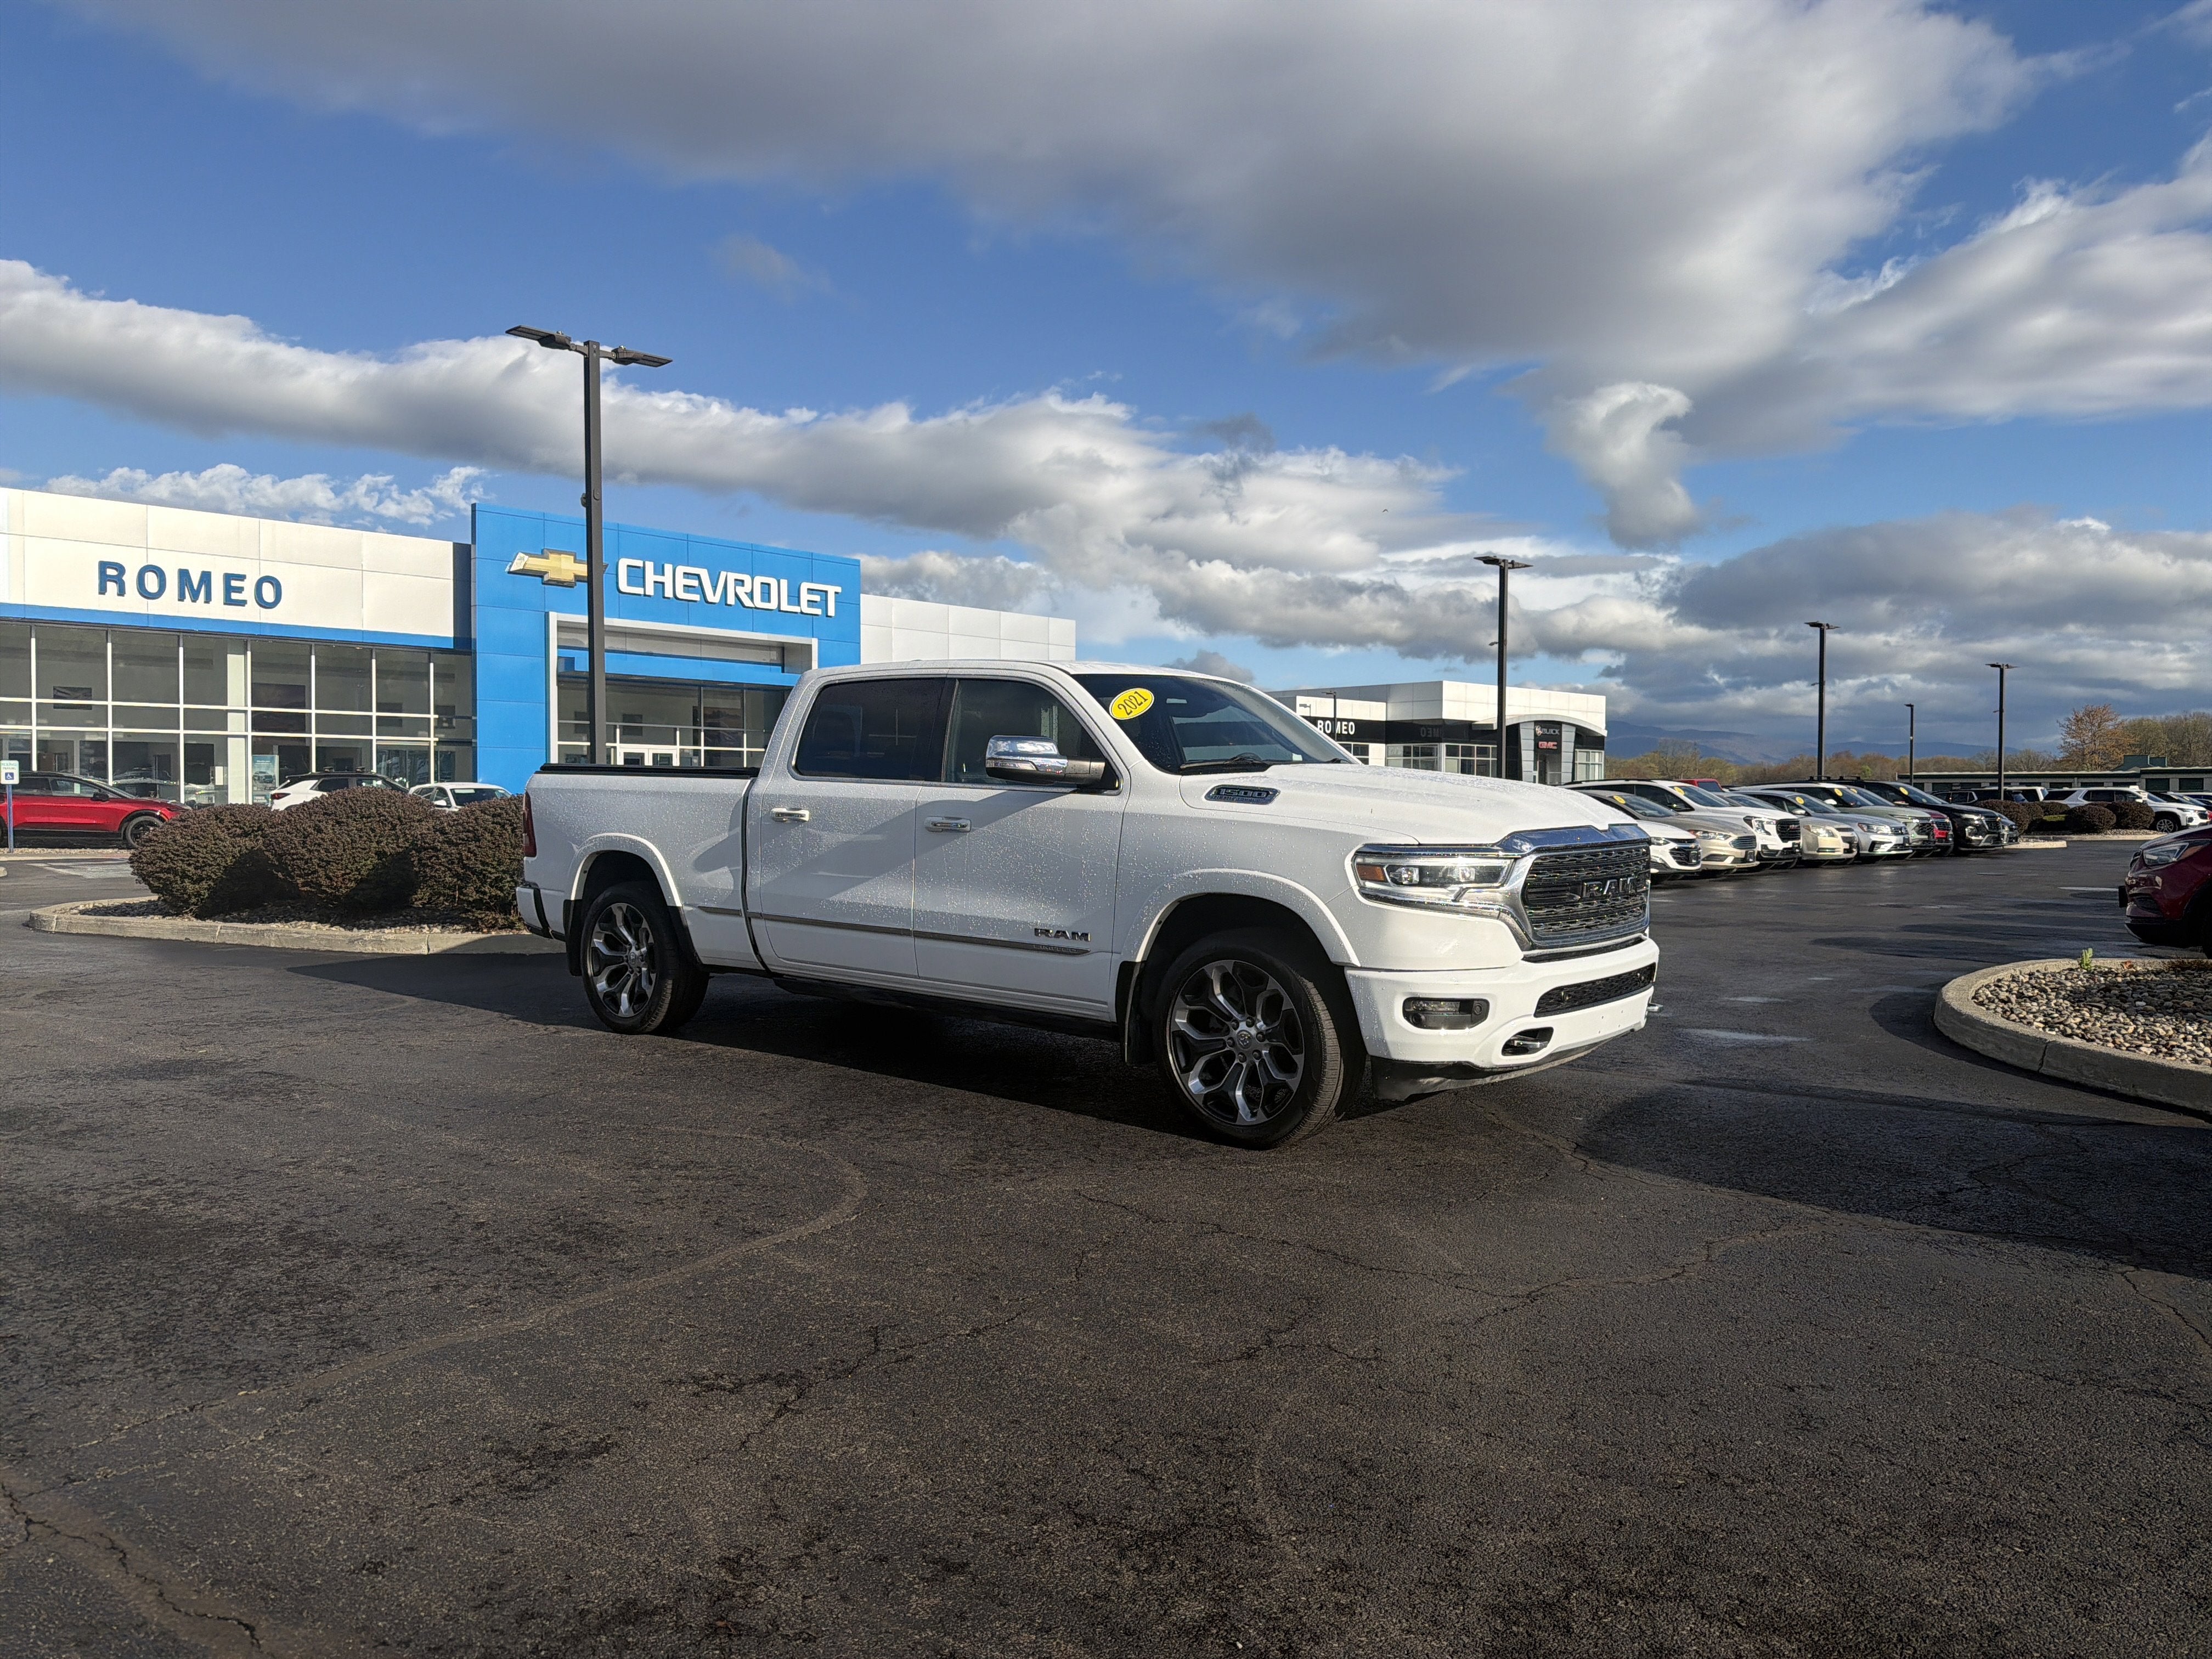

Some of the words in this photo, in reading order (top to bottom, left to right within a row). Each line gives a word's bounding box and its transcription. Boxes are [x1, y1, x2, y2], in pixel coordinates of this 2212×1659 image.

[98, 560, 283, 610] ROMEO
[617, 557, 842, 617] CHEVROLET
[1118, 691, 1148, 715] 2021
[1317, 720, 1355, 735] ROMEO
[1538, 741, 1558, 749] GMC
[1219, 788, 1266, 798] 1500
[1583, 876, 1637, 898] RAM
[1034, 928, 1091, 942] RAM
[1033, 944, 1077, 953] LIMITED
